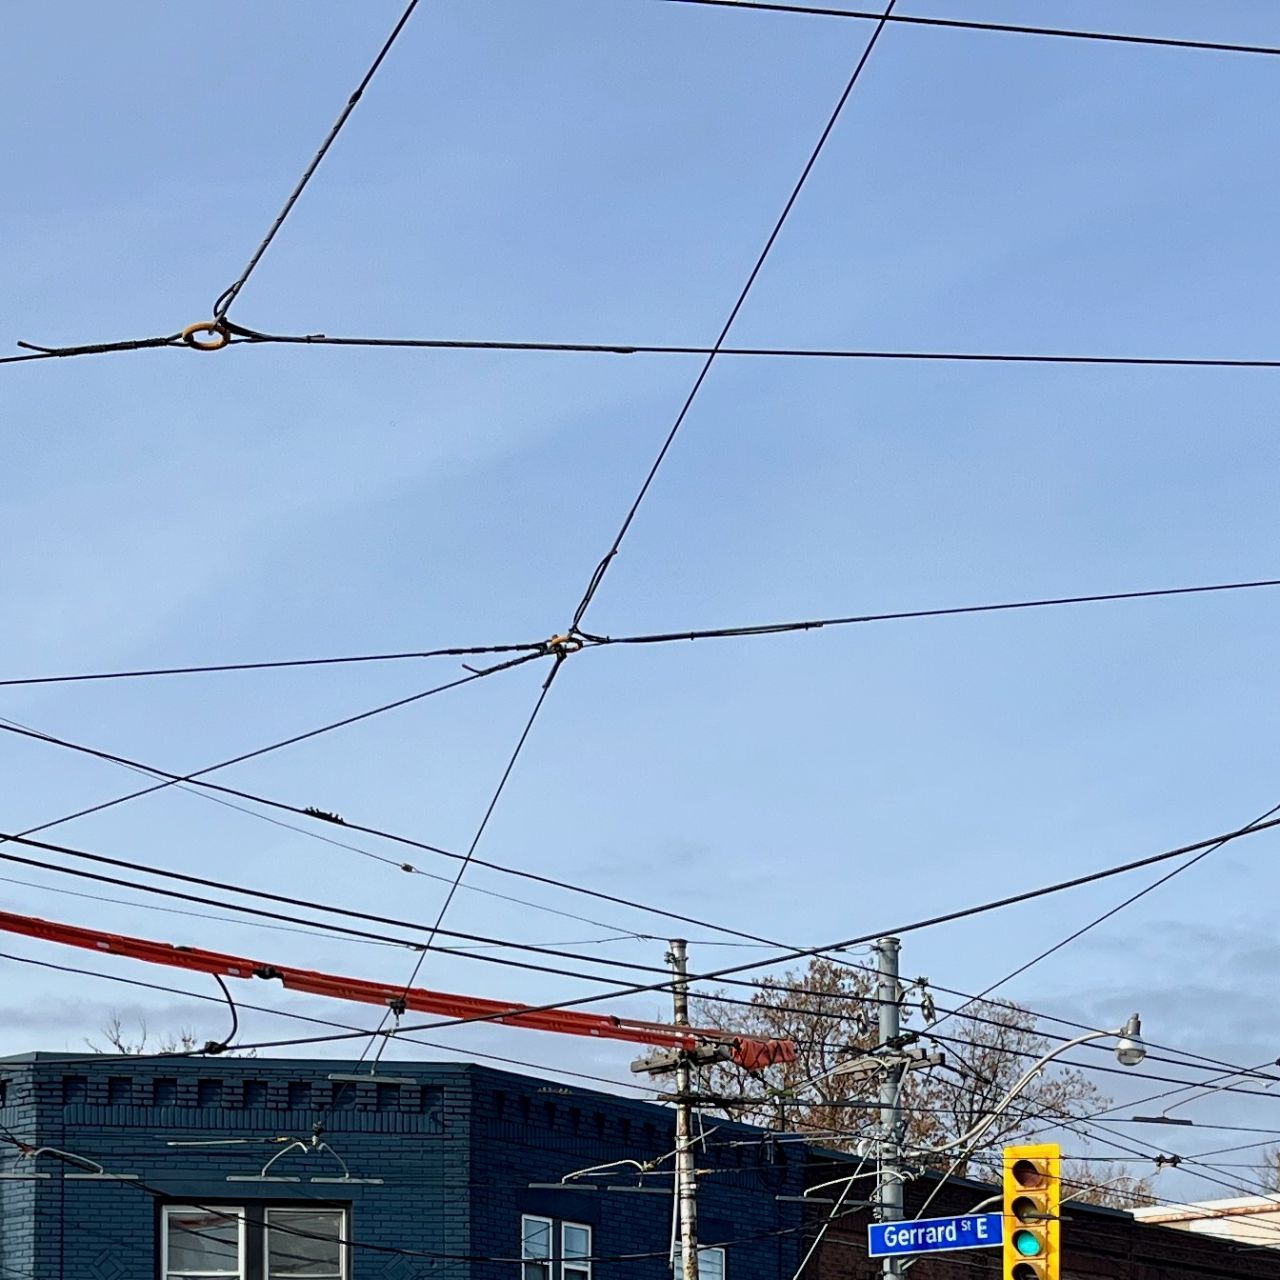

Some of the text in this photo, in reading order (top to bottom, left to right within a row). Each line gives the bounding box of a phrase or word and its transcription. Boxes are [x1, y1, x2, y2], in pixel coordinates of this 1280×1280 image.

[884, 1218, 988, 1247] Gerrard St E
